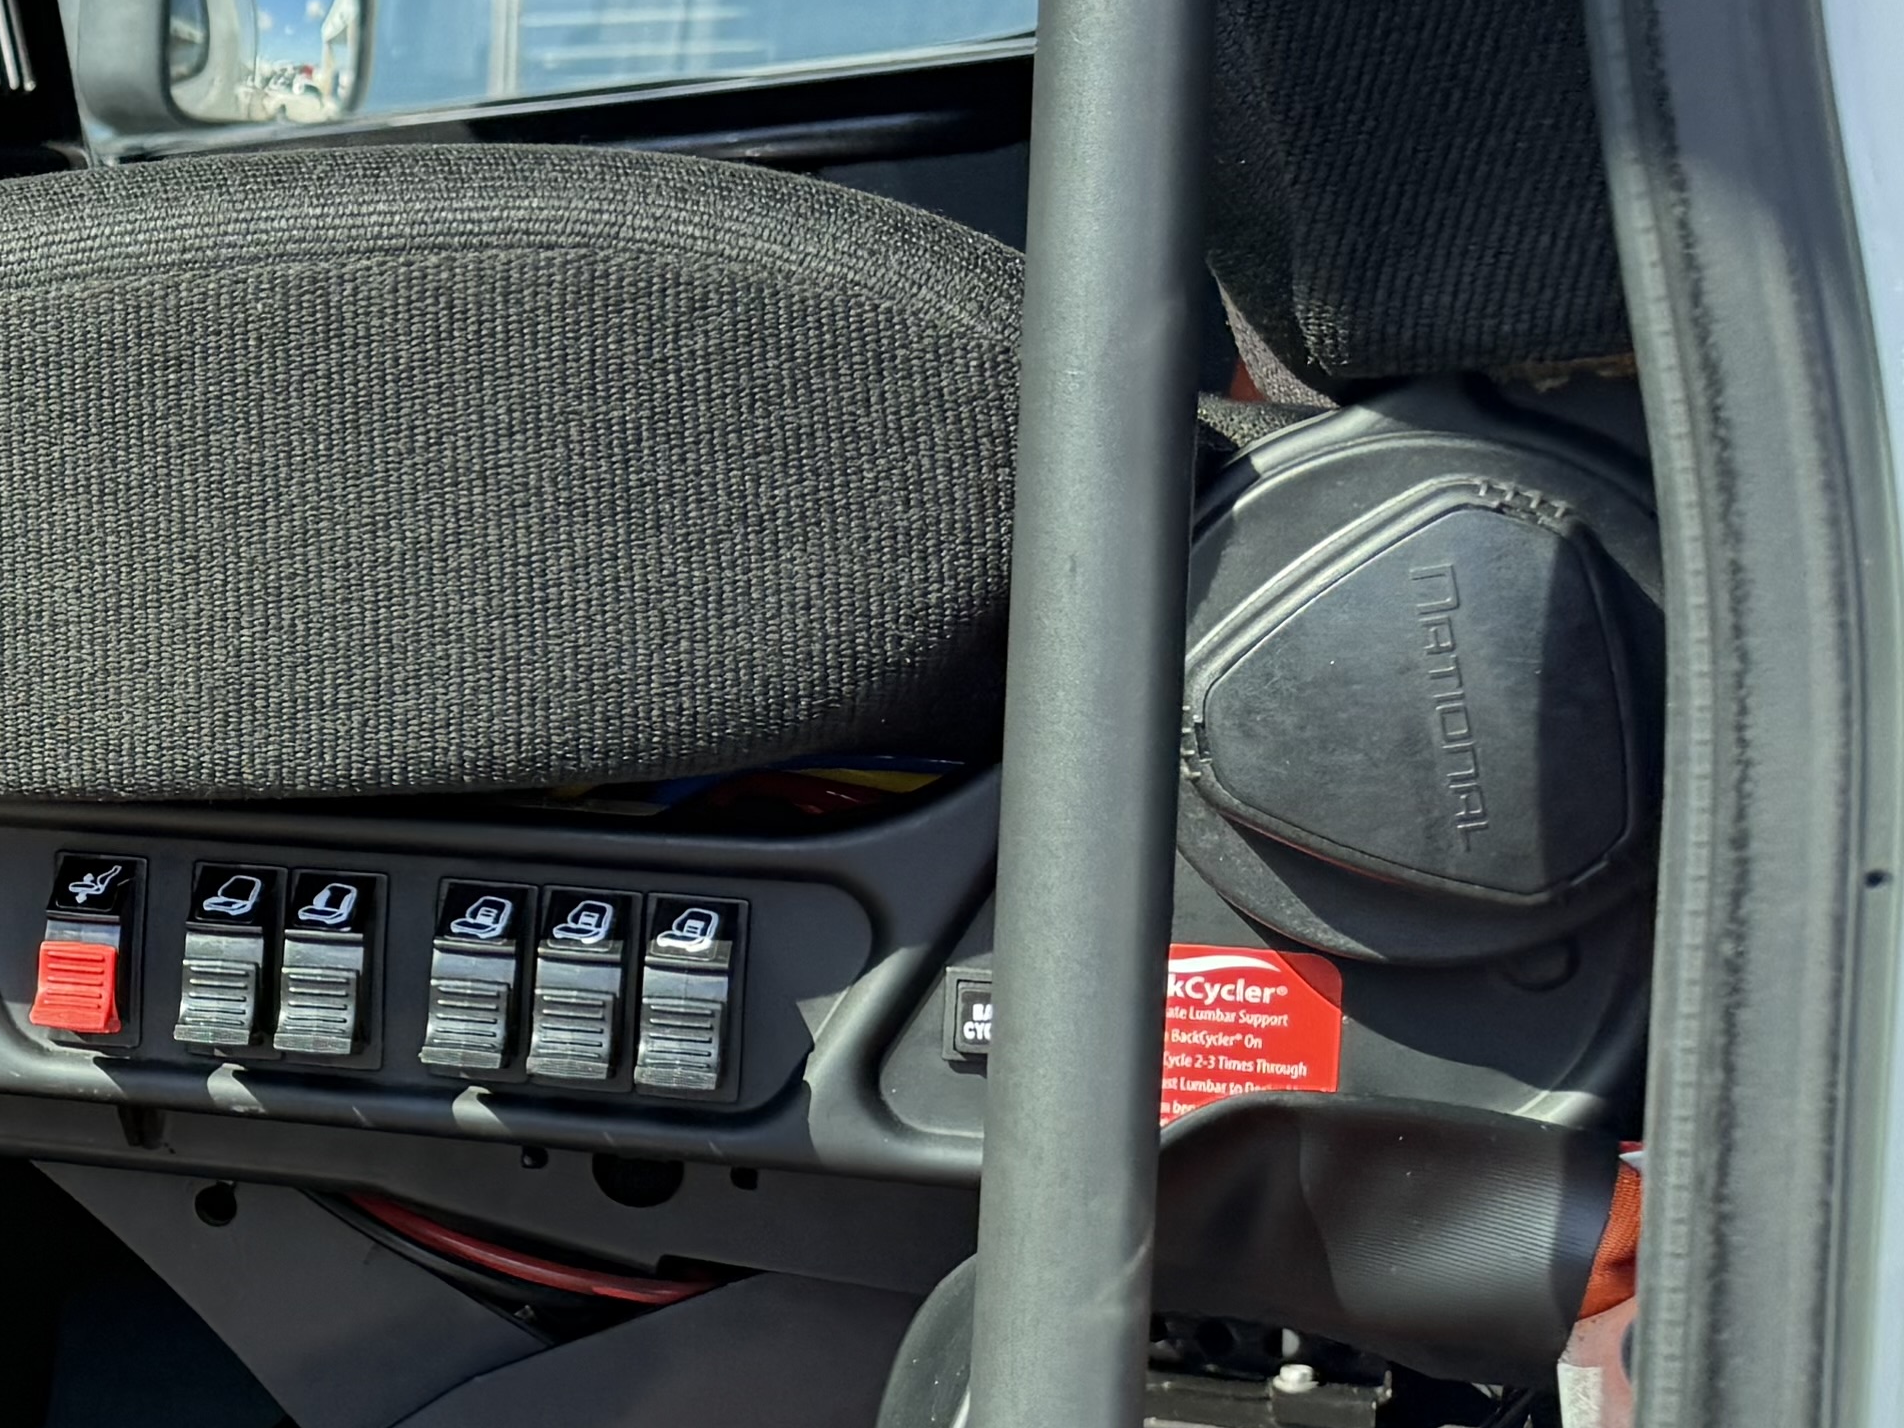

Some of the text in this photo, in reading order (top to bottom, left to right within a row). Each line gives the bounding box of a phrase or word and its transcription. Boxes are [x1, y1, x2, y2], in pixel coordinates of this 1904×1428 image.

[1169, 974, 1288, 1005] kCycler®
[972, 1003, 993, 1021] BA
[1189, 1007, 1236, 1022] Lumbar
[1239, 1010, 1289, 1028] Support
[963, 1021, 992, 1040] CYC
[1244, 1036, 1263, 1050] On
[1194, 1054, 1216, 1068] 2-3
[1218, 1056, 1254, 1072] Times
[1256, 1059, 1308, 1079] Through
[1179, 1077, 1227, 1093] Lumbar
